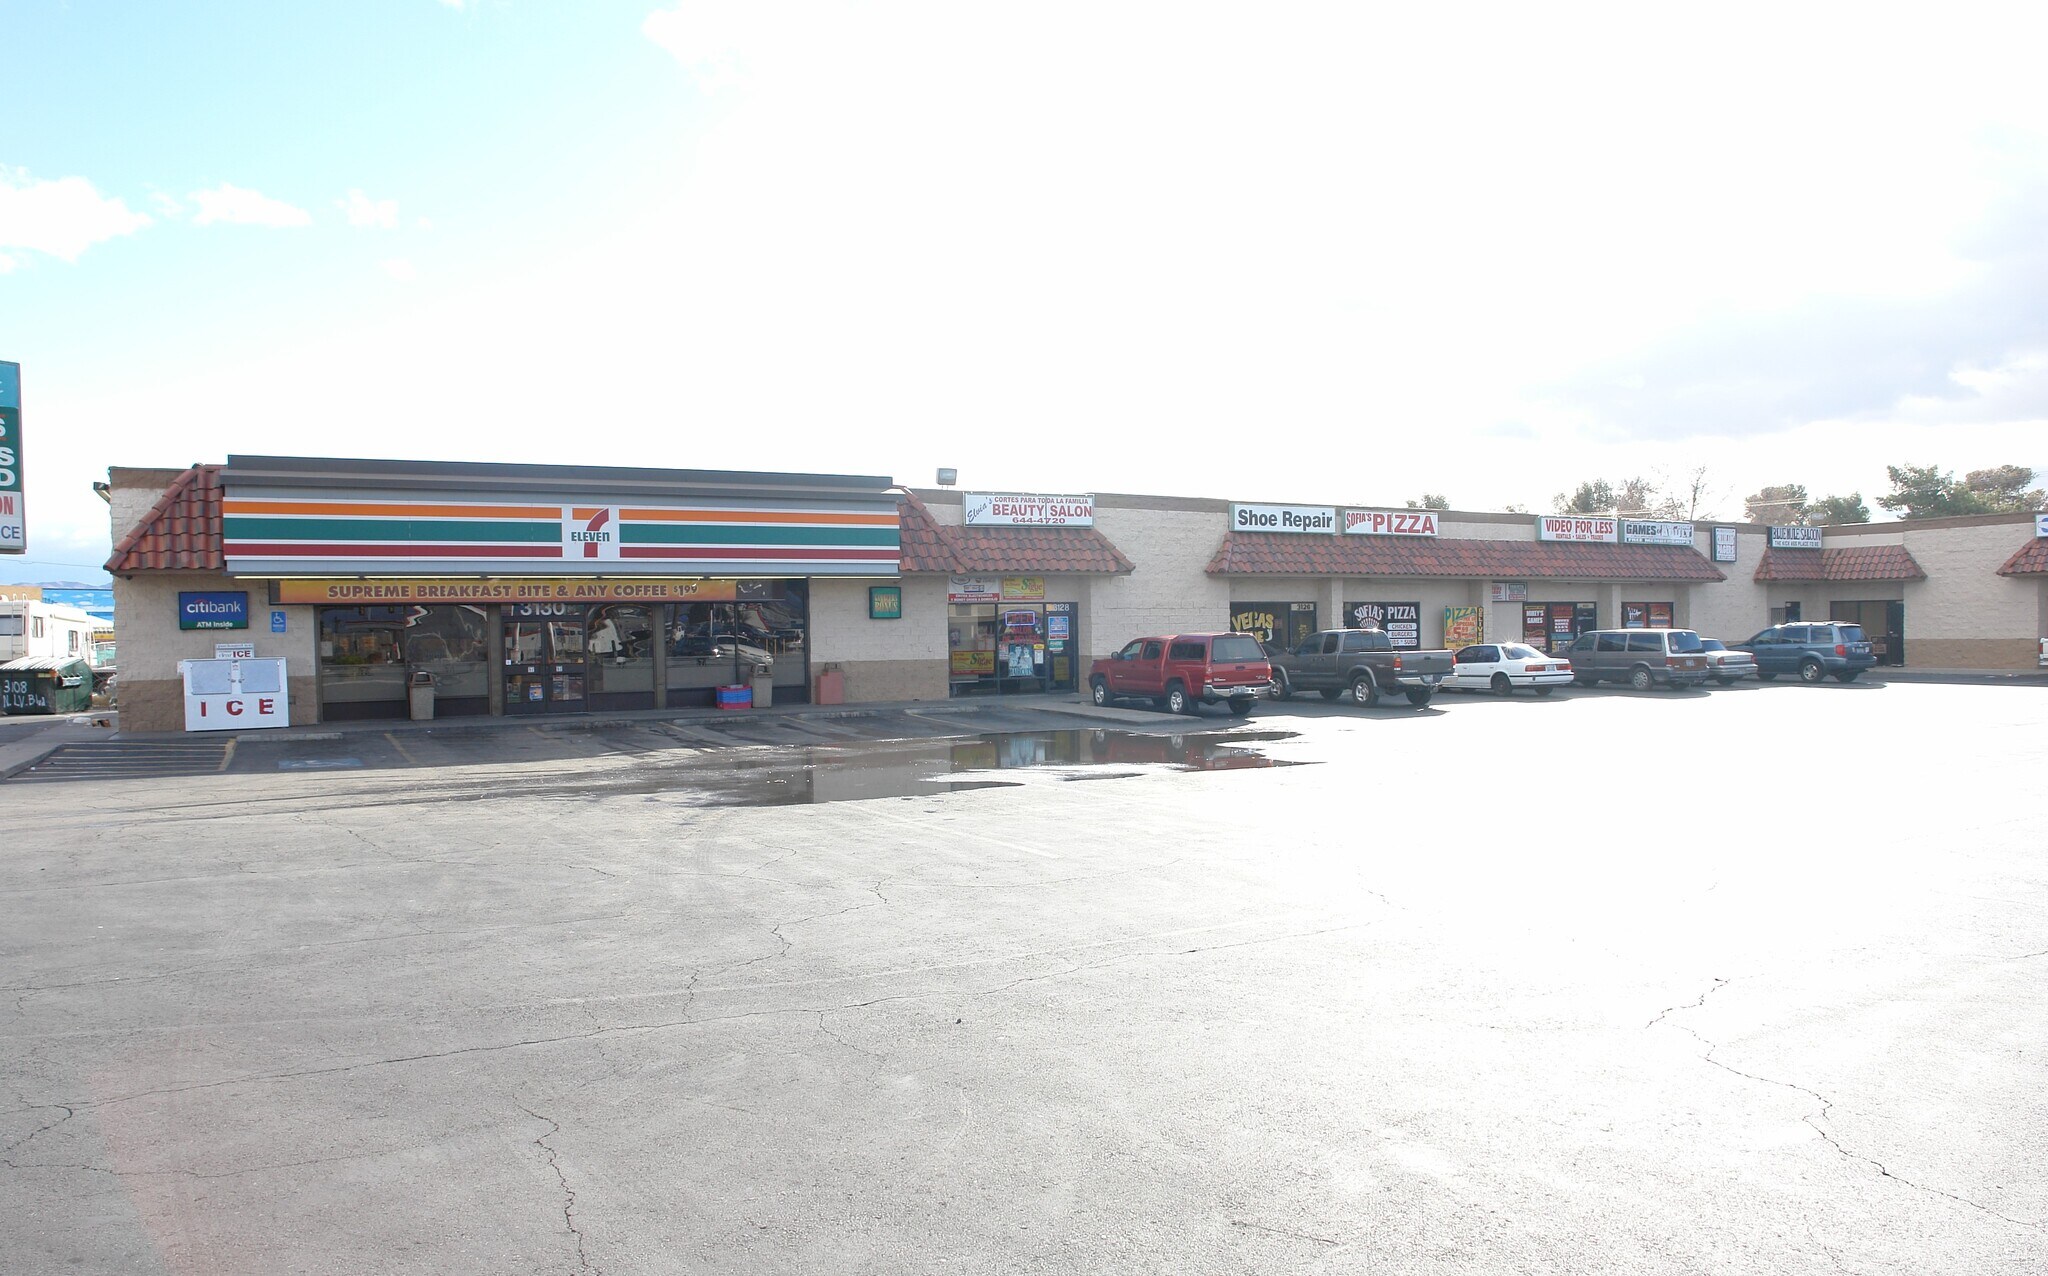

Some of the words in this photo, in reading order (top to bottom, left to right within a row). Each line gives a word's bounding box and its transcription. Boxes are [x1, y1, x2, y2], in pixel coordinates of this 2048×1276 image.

[992, 503, 1045, 516] BEAUTY
[1049, 504, 1092, 517] SALON
[1238, 509, 1278, 527] Shoe
[1282, 510, 1333, 531] Repair
[1346, 511, 1372, 530] SOFIA'S
[1372, 514, 1435, 534] PIZZA
[1545, 519, 1573, 533] VIDEO
[1575, 520, 1593, 534] FOR
[1595, 521, 1613, 534] LESS
[1626, 524, 1657, 535] GAMES
[1773, 527, 1787, 540] BLUE
[1800, 528, 1821, 541] SALOON
[328, 585, 410, 598] SUPREME
[416, 585, 512, 598] BREAKFAST
[517, 585, 551, 597] BITE
[556, 585, 569, 597] &
[575, 585, 608, 597] ANY
[613, 585, 667, 597] COFFEE
[187, 601, 241, 613] citibank
[520, 603, 565, 616] 3130
[1354, 604, 1385, 621] SOFIA'S
[1387, 606, 1417, 619] PIZZA
[1231, 611, 1274, 632] VEGAS
[1444, 607, 1476, 630] PIZZA
[232, 650, 251, 658] ICE
[4, 680, 27, 693] 3108
[200, 698, 274, 718] ICE
